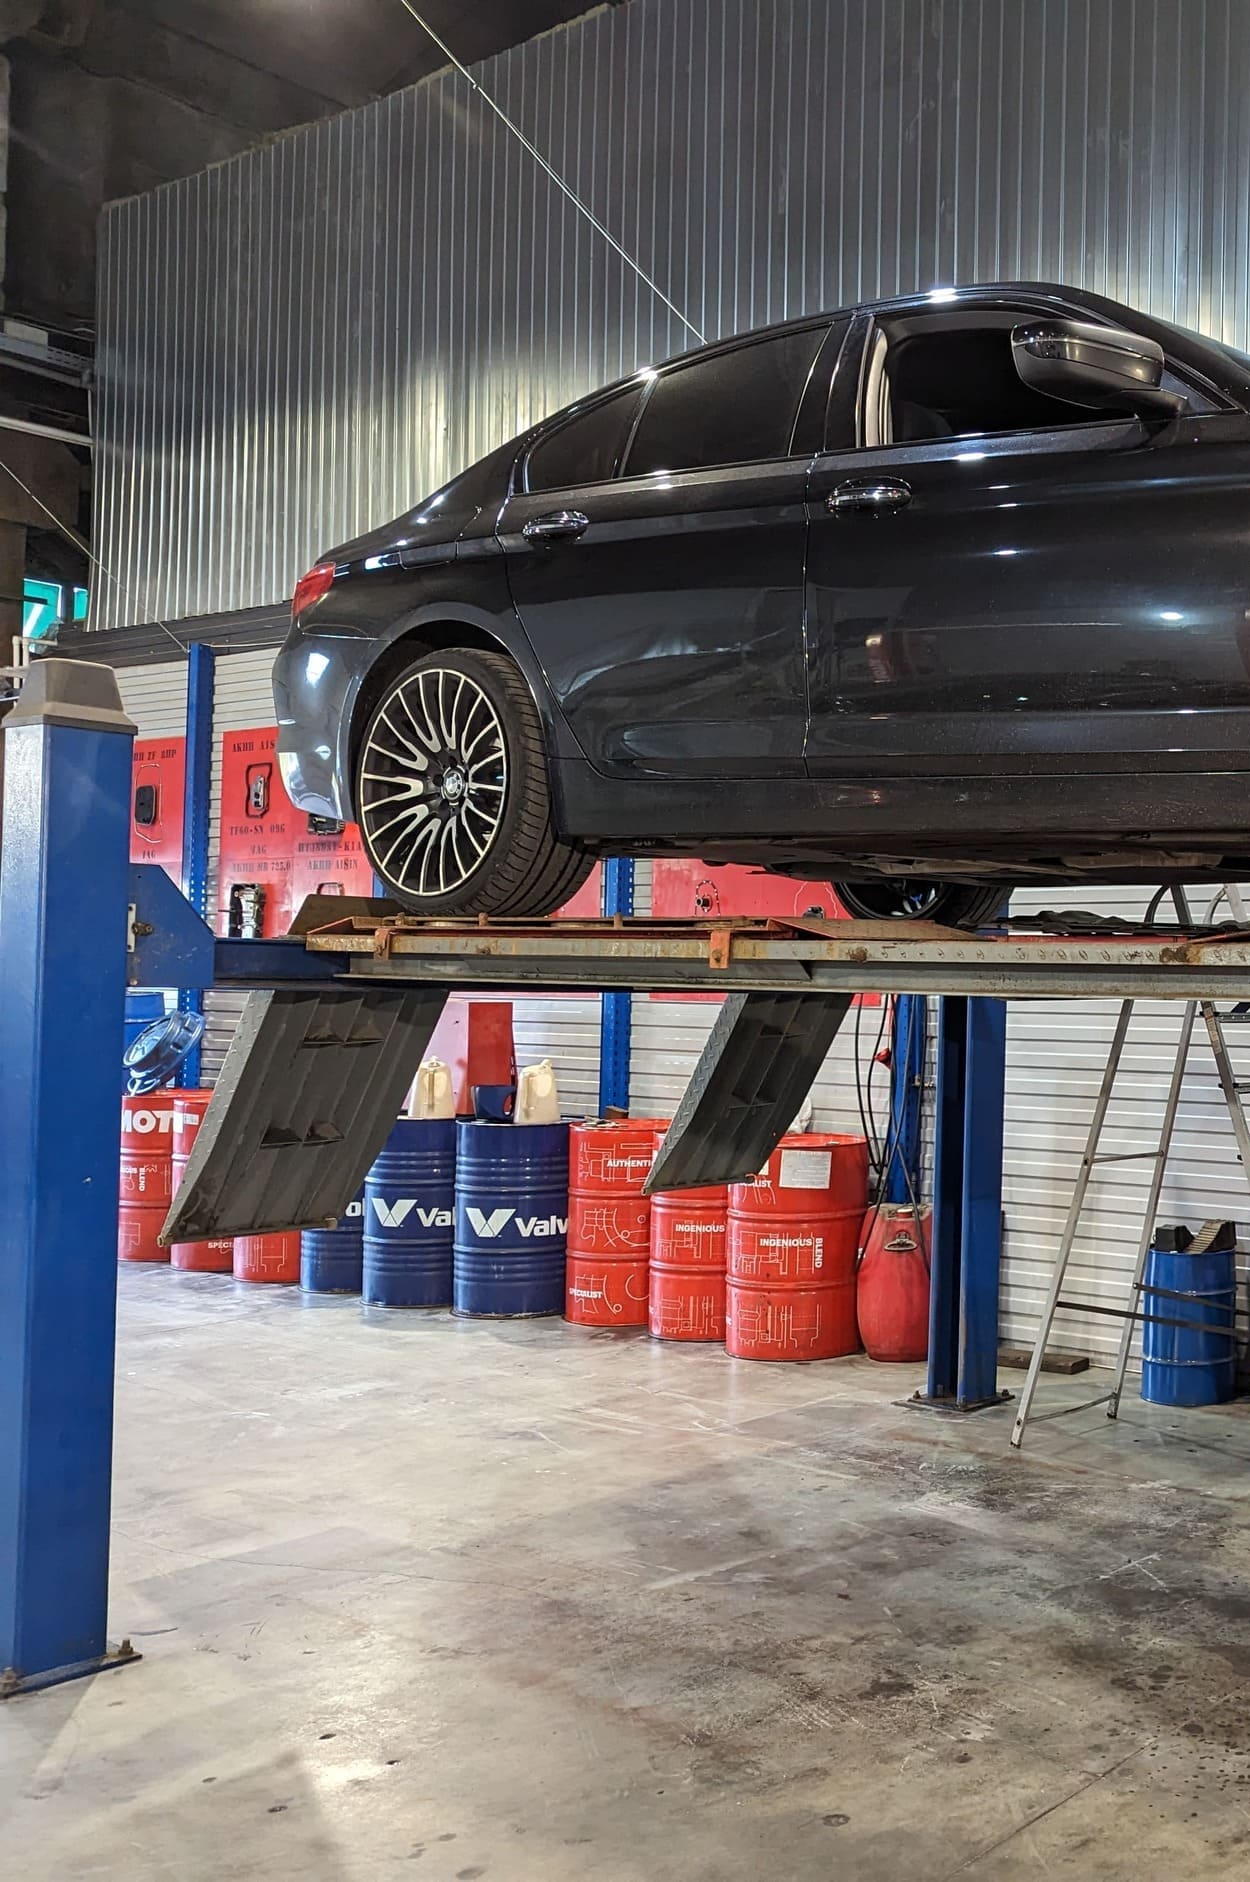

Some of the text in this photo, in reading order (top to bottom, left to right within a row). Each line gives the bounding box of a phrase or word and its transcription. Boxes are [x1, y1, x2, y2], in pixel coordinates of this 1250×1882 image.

[675, 1224, 725, 1233] INGENIOUS
[760, 1238, 813, 1247] INGENIOUS
[815, 1238, 823, 1268] BLEND
